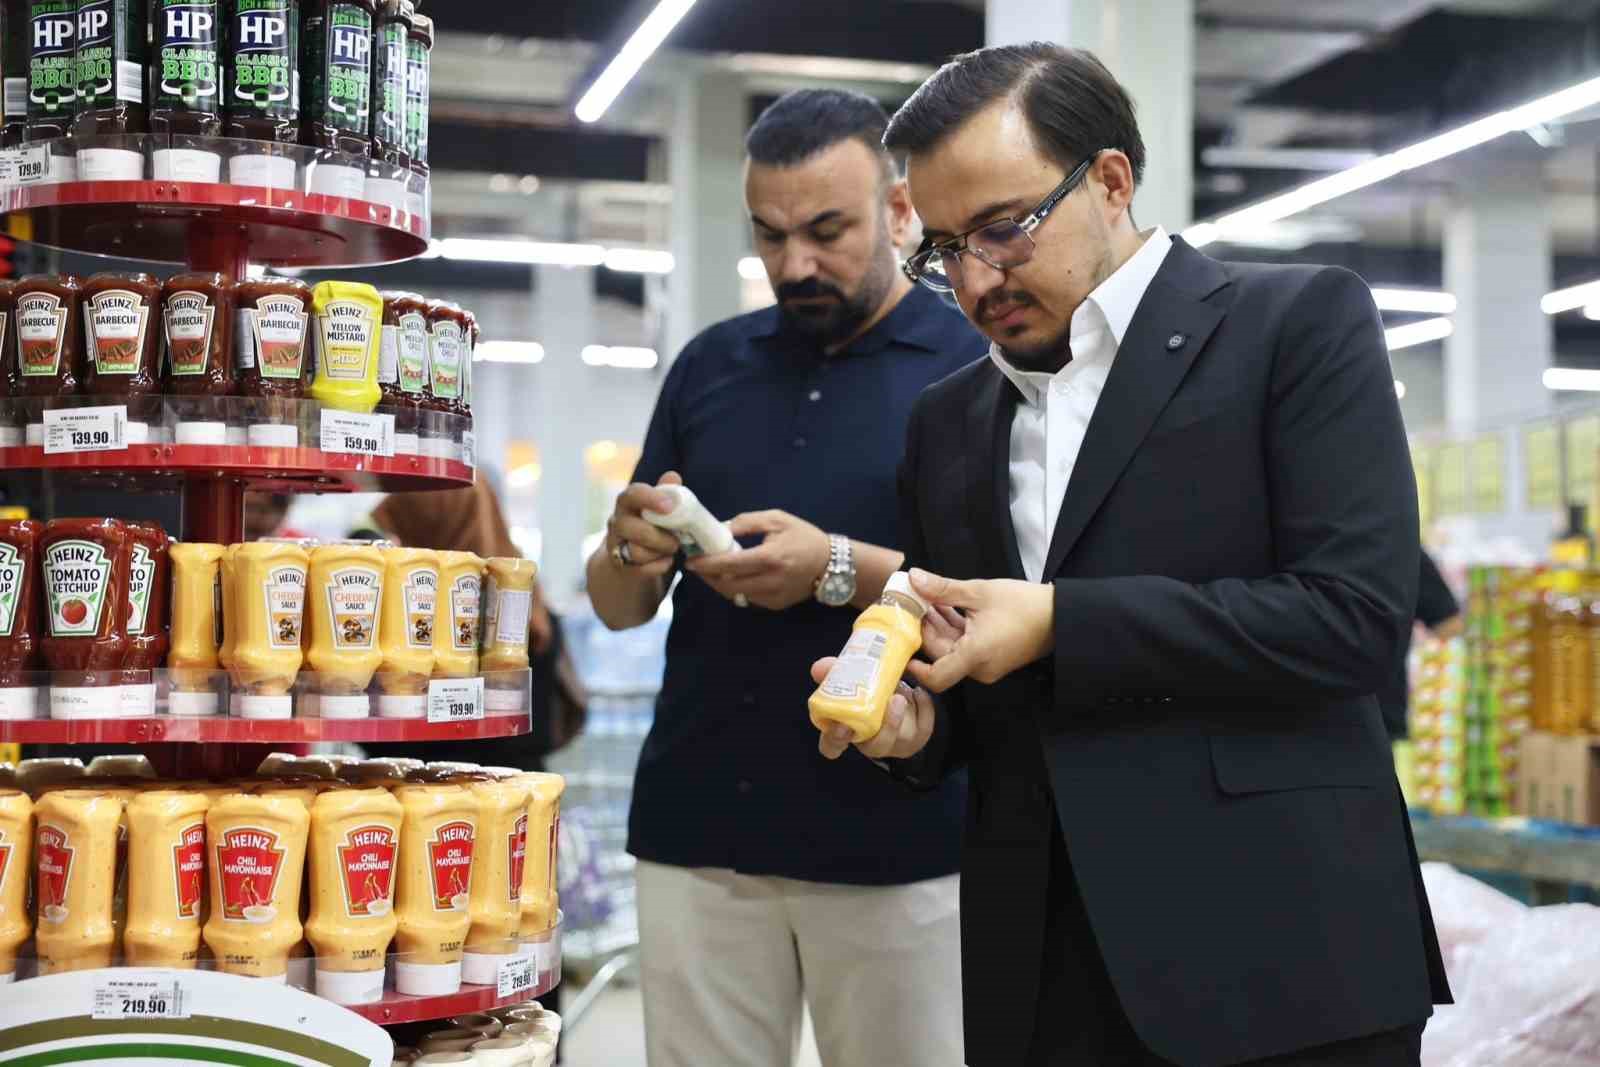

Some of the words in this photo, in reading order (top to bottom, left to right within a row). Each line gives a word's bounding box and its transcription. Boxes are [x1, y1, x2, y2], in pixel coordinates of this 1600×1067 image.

[78, 10, 108, 40] HP
[166, 10, 213, 39] HP
[239, 16, 285, 44] HP
[34, 20, 74, 48] HP
[334, 29, 369, 60] HP
[161, 48, 216, 63] CLASSIC
[235, 53, 288, 67] CLASSIC
[162, 60, 216, 81] BBQ
[235, 65, 288, 86] BBQ
[24, 299, 50, 311] HEINZ
[100, 296, 131, 310] HEINZ
[173, 299, 198, 311] HEINZ
[267, 302, 296, 315] HEINZ
[331, 306, 362, 319] HEINZ
[20, 315, 57, 327] BARBECUE
[95, 314, 137, 326] BARBECUE
[170, 315, 204, 326] BARBECUE
[260, 319, 301, 330] BARBECUE
[331, 322, 361, 332] YELLOW
[327, 331, 366, 342] MUSTARD
[54, 547, 94, 564] HEINZ
[50, 568, 101, 582] TOMATO
[279, 573, 300, 585] HEINZ
[341, 575, 371, 587] HEINZ
[52, 582, 98, 593] KETCHUP
[345, 602, 366, 610] SAUCE
[230, 833, 270, 850] HEINZ
[354, 831, 388, 847] HEINZ
[442, 827, 470, 843] HEINZ
[224, 864, 273, 875] MAYONNAISE
[347, 860, 390, 872] MAYONNAISE
